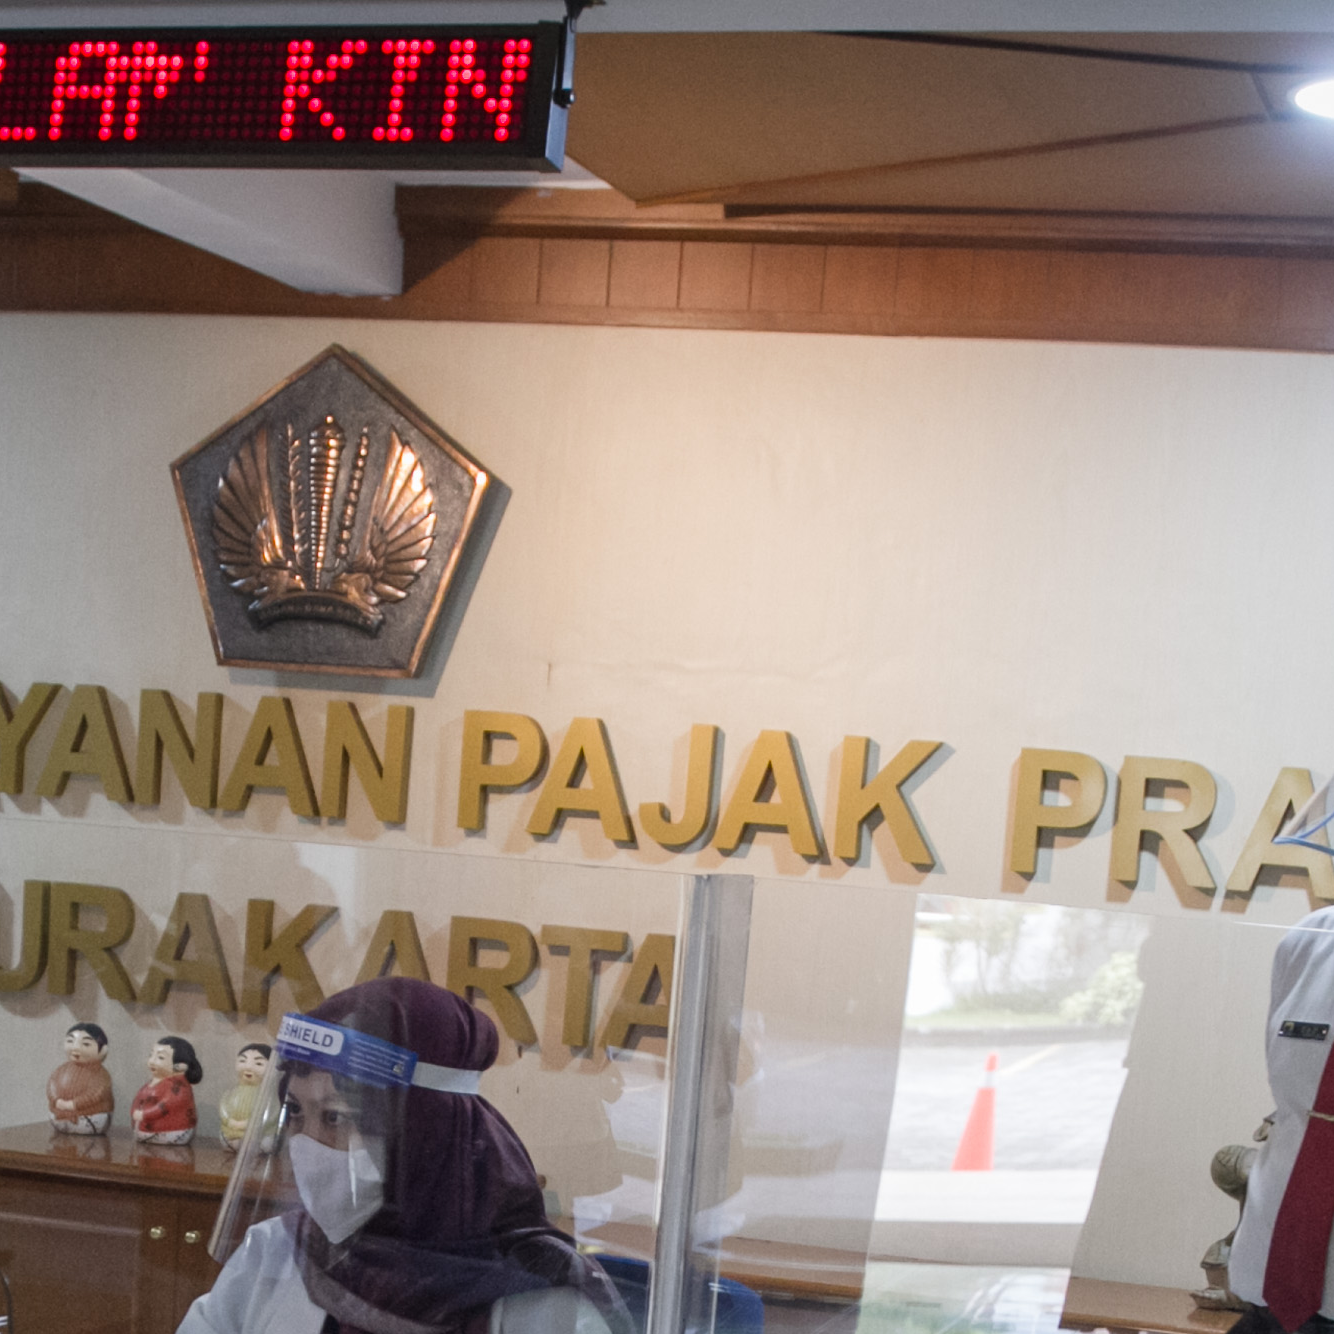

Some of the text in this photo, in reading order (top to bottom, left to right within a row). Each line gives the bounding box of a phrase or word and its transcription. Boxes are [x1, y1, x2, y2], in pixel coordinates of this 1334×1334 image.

[279, 39, 533, 142] KIN
[457, 709, 944, 869] PAJAK
[283, 1022, 334, 1048] SHIELD
